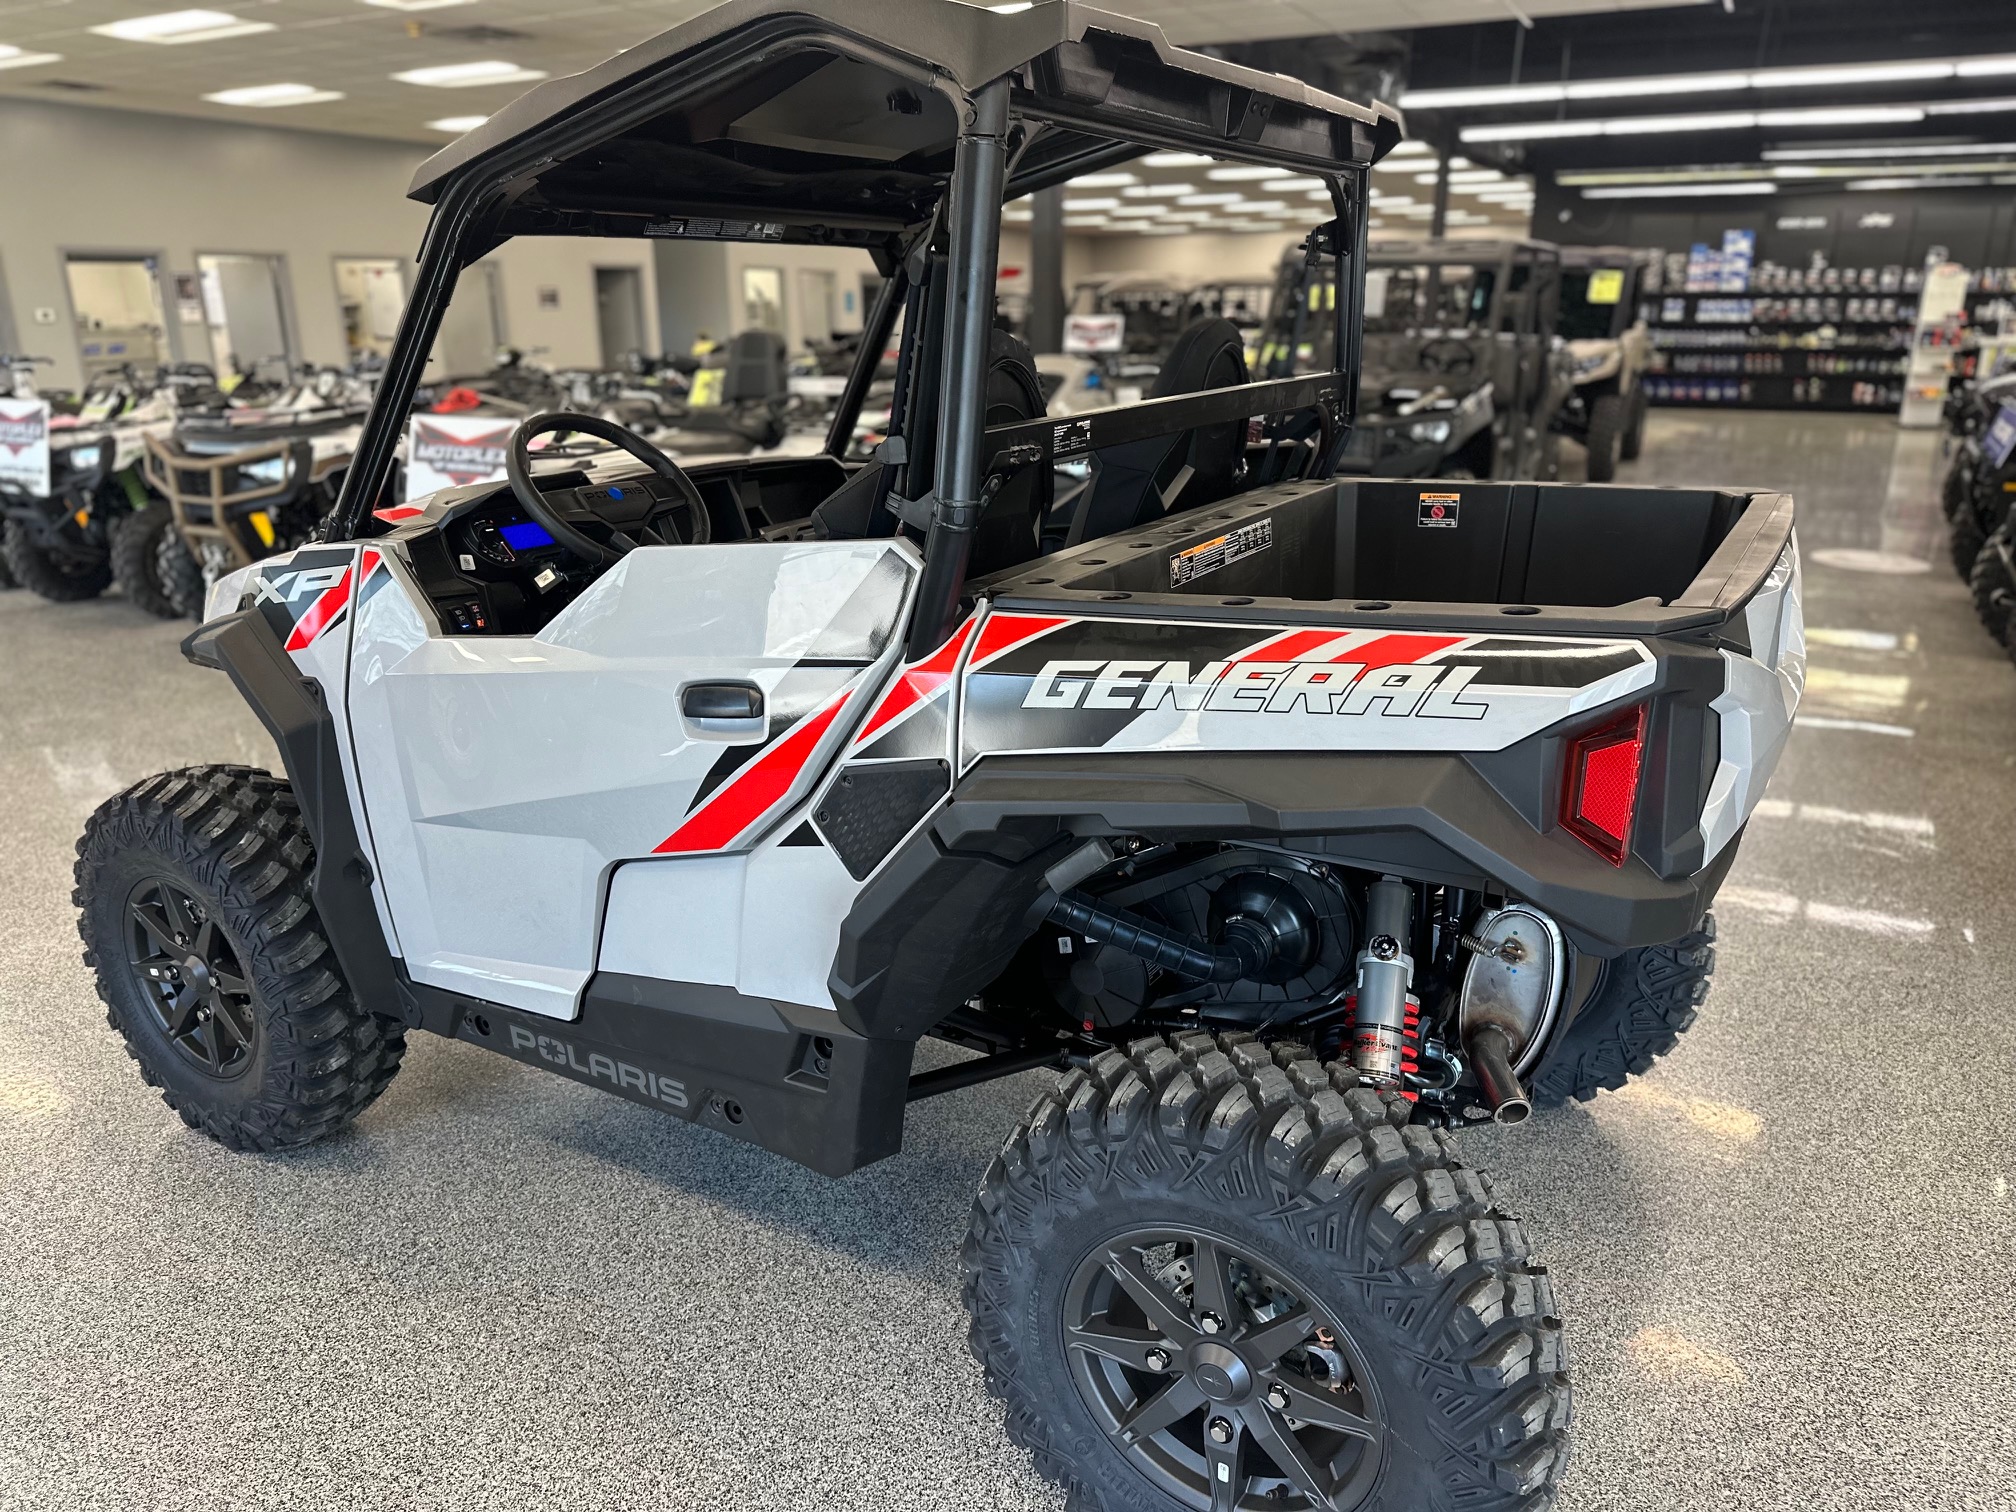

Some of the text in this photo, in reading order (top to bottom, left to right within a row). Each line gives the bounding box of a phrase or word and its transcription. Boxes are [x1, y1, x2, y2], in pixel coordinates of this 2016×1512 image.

[584, 486, 645, 499] POLRIS
[253, 565, 350, 607] XP
[1020, 659, 1489, 720] GENERAL
[509, 1024, 689, 1109] POLARIS
